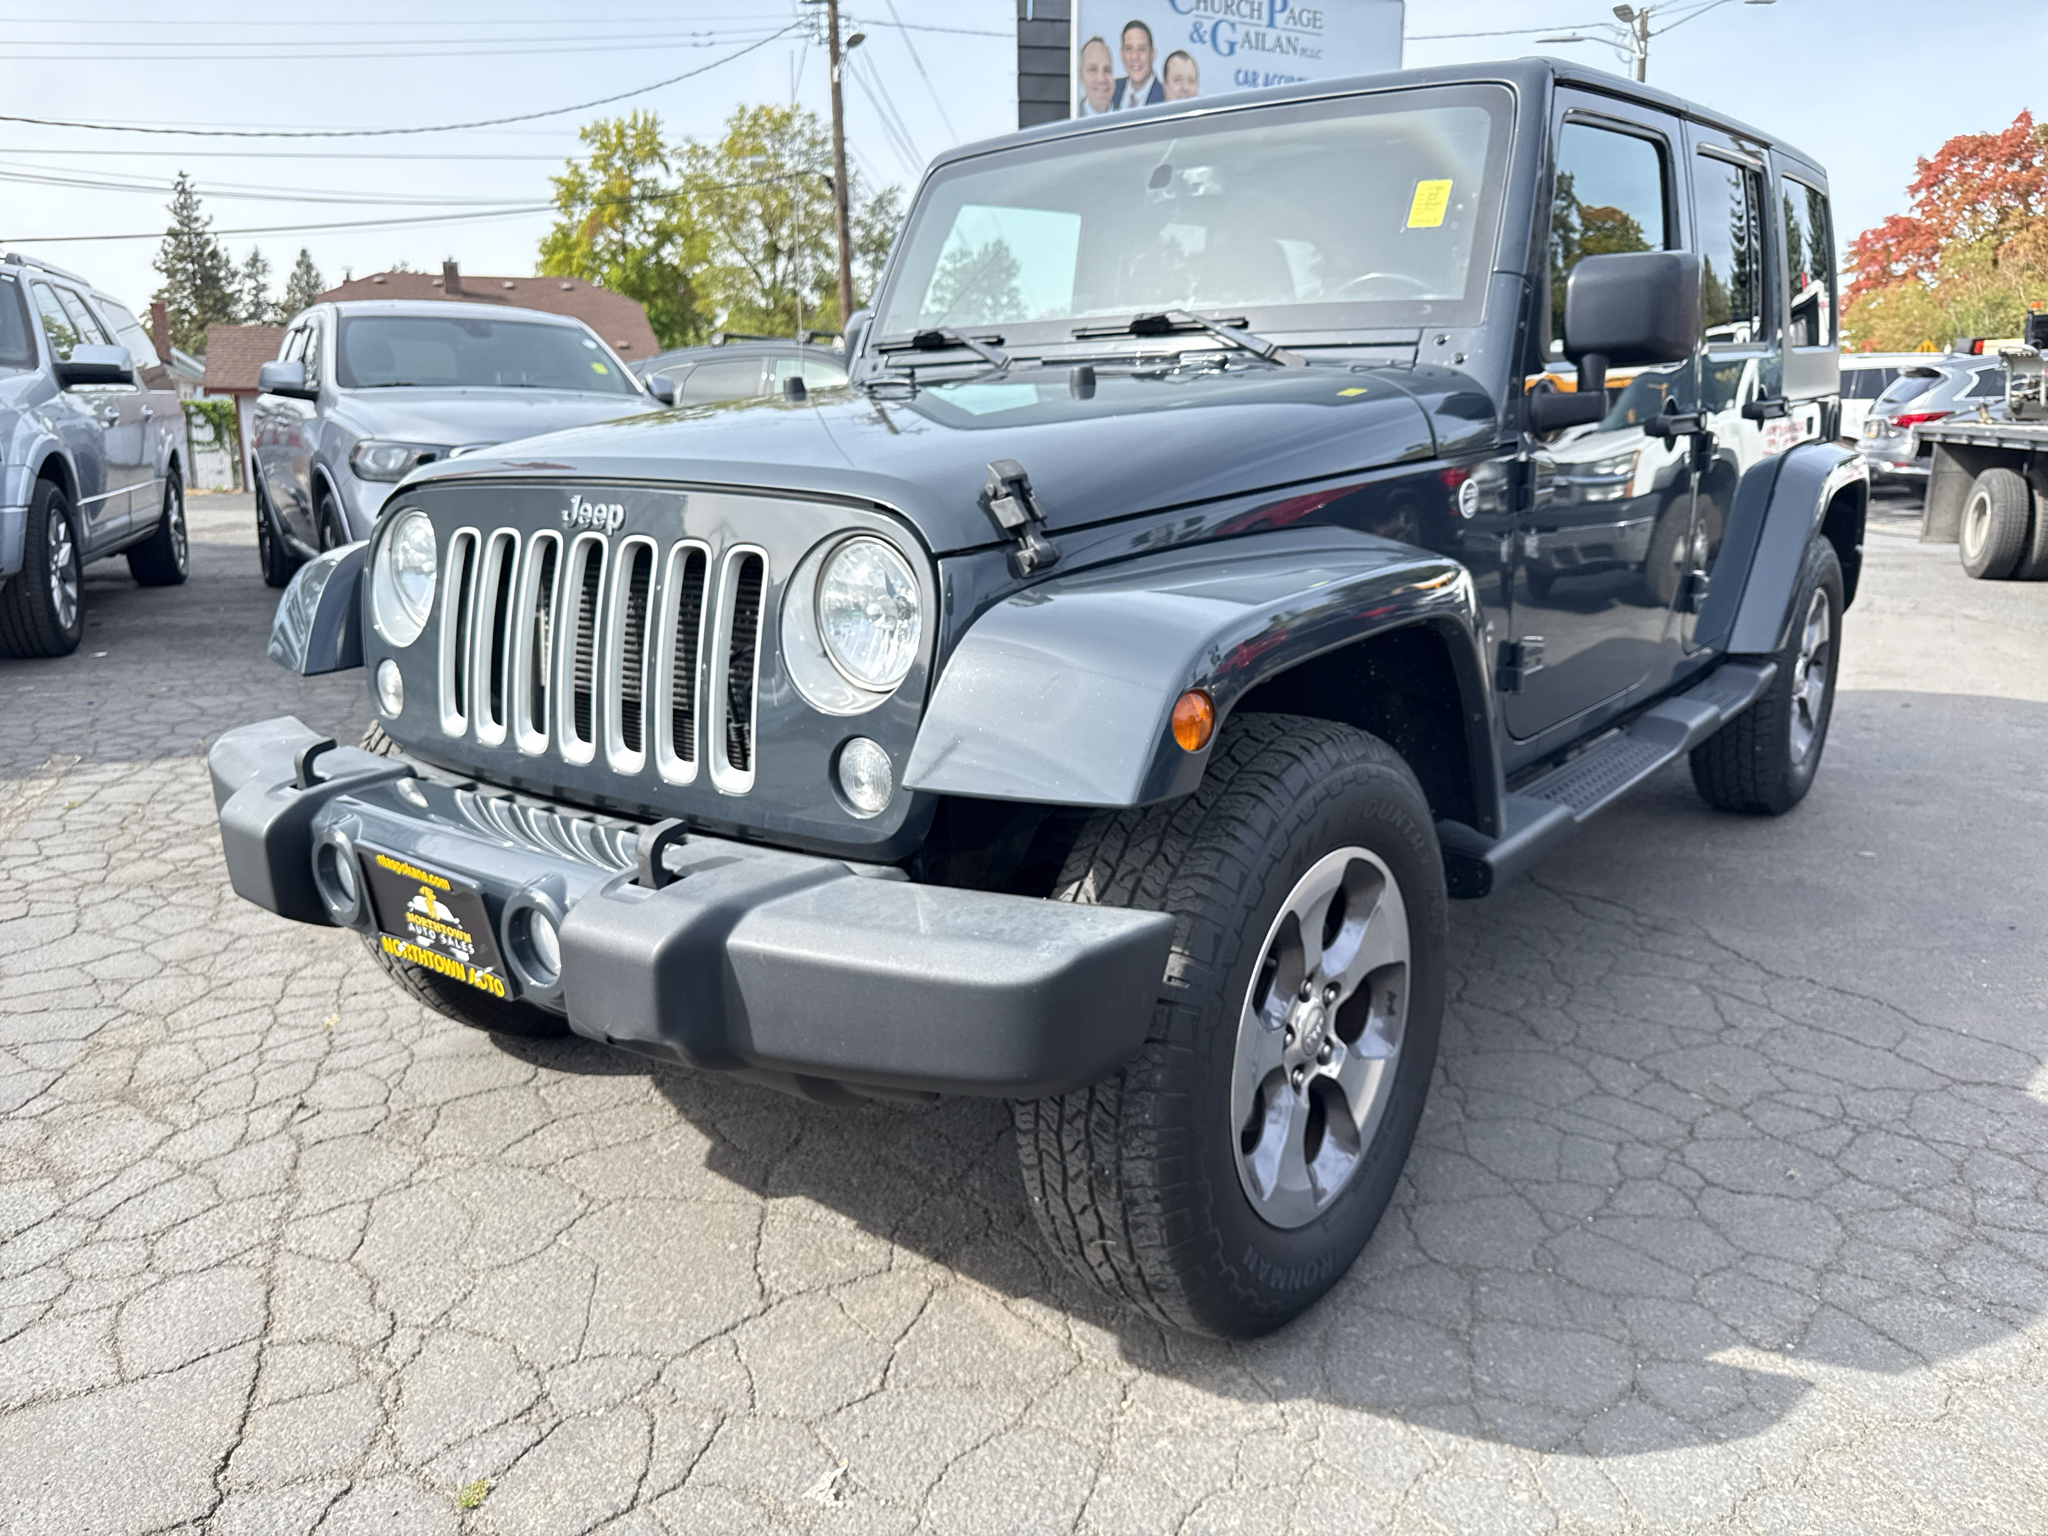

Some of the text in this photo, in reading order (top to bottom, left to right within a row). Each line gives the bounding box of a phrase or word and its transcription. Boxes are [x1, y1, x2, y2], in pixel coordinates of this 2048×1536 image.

[1266, 0, 1325, 30] PAGE
[561, 494, 625, 536] Jeep
[405, 911, 473, 943] NORTHTOWN
[406, 922, 475, 955] AUTO SALES
[381, 935, 505, 998] NORTHTOWN AUTO
